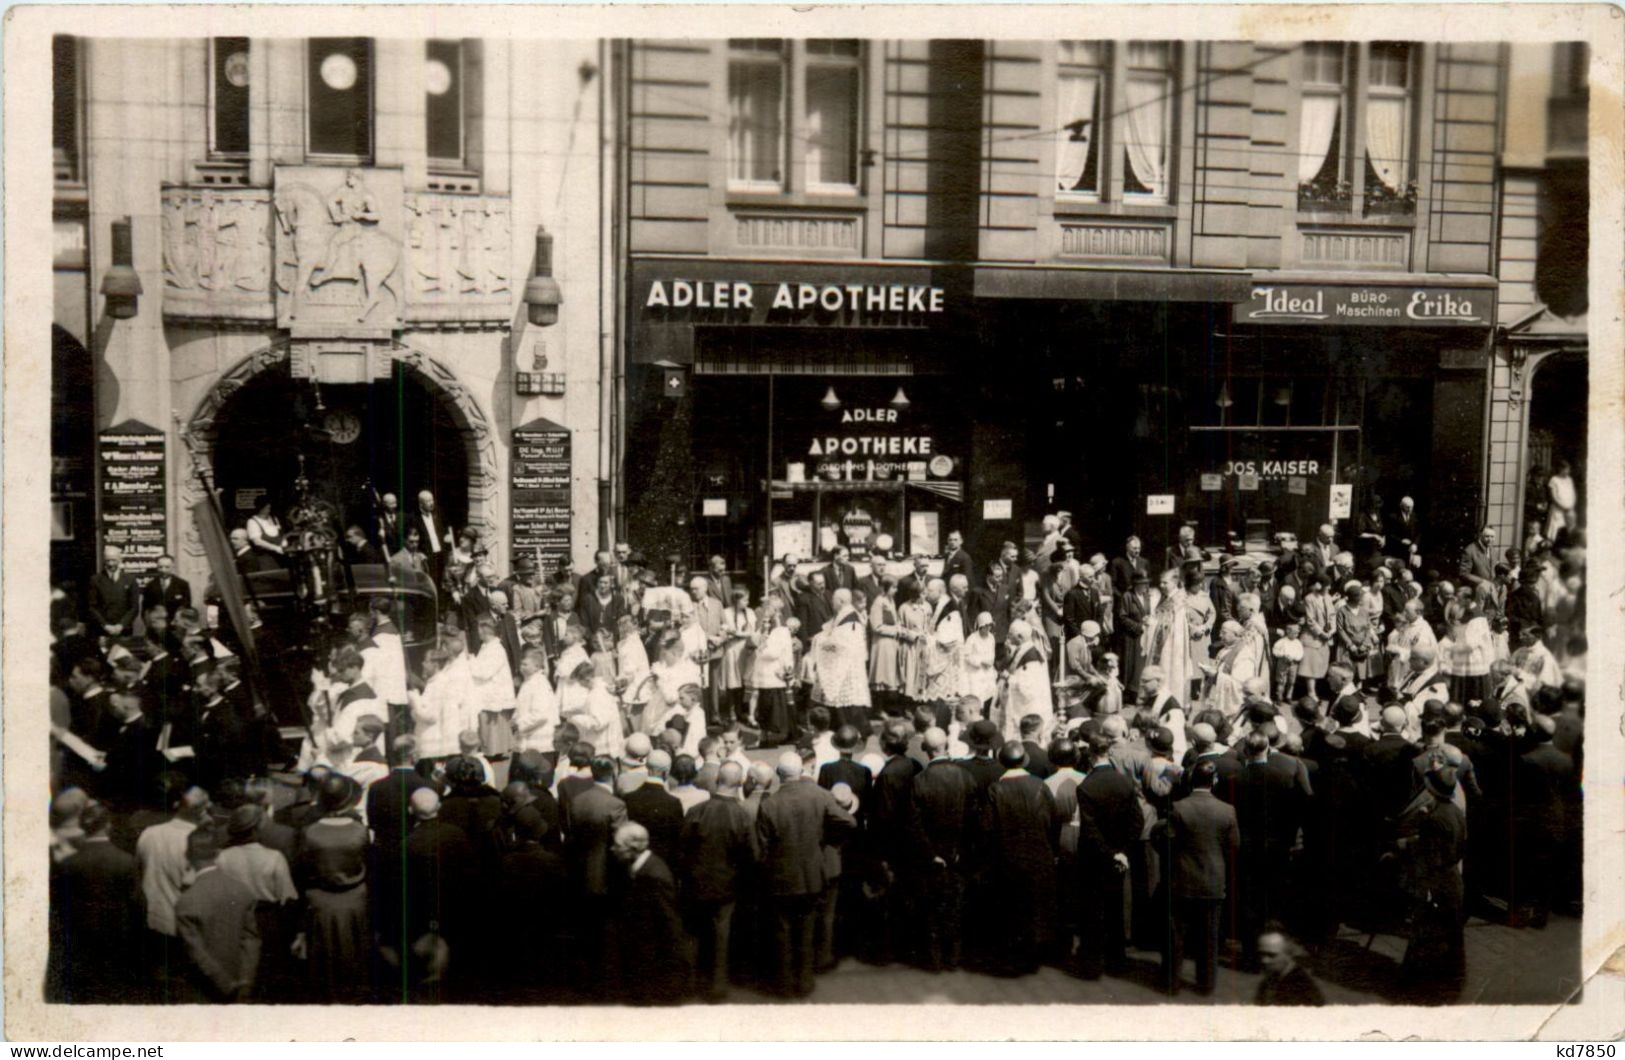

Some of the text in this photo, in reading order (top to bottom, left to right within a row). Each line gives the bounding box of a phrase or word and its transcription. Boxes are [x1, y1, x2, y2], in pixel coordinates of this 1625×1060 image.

[647, 281, 944, 312] ADLER APOTHEKE
[1250, 287, 1325, 316] Ideal
[1406, 291, 1475, 318] Erika
[1336, 305, 1400, 317] Maschinen
[841, 408, 898, 423] ADLER
[808, 437, 932, 455] APOTHEKE
[1262, 460, 1319, 475] KAISER
